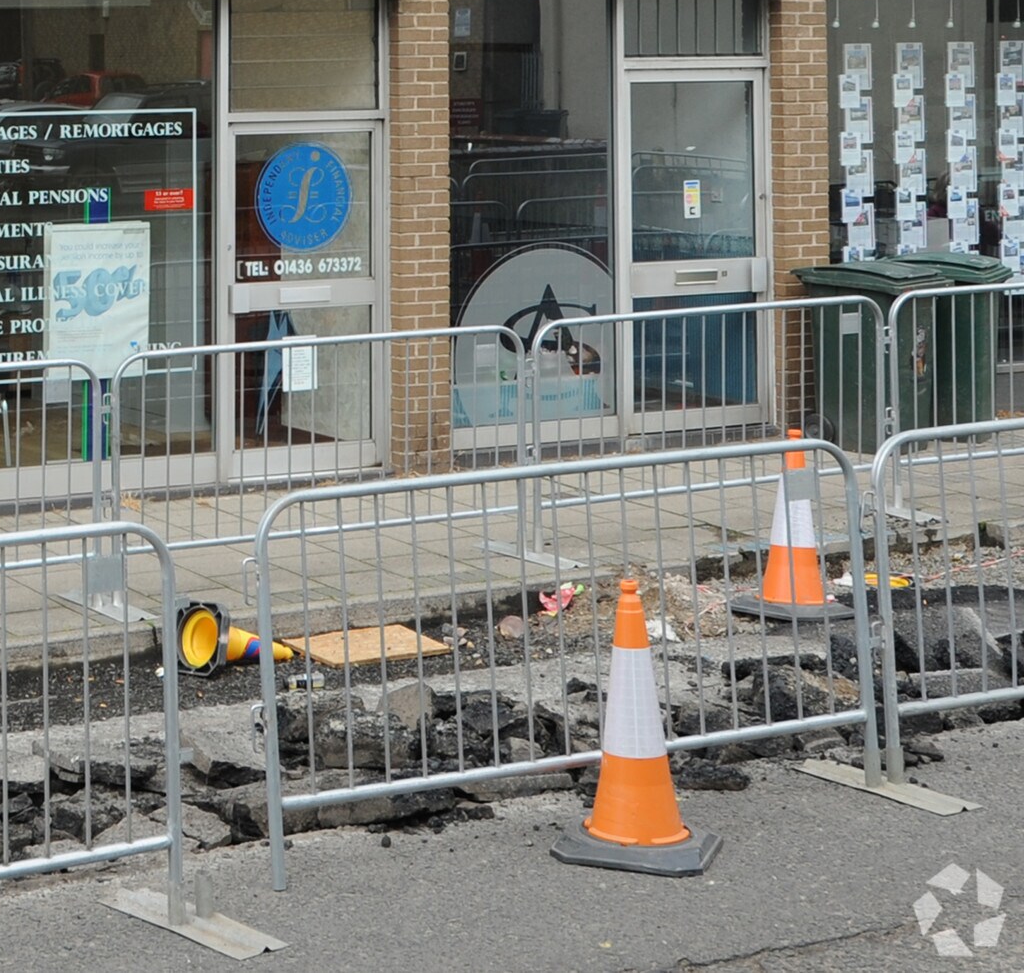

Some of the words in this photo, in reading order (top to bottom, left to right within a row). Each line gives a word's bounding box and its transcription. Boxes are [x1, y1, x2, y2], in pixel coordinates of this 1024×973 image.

[60, 121, 183, 139] REMORTGAGES
[28, 188, 109, 206] PENSIONS
[245, 261, 269, 277] TEL:
[274, 258, 314, 275] 01436
[318, 256, 361, 274] 673372
